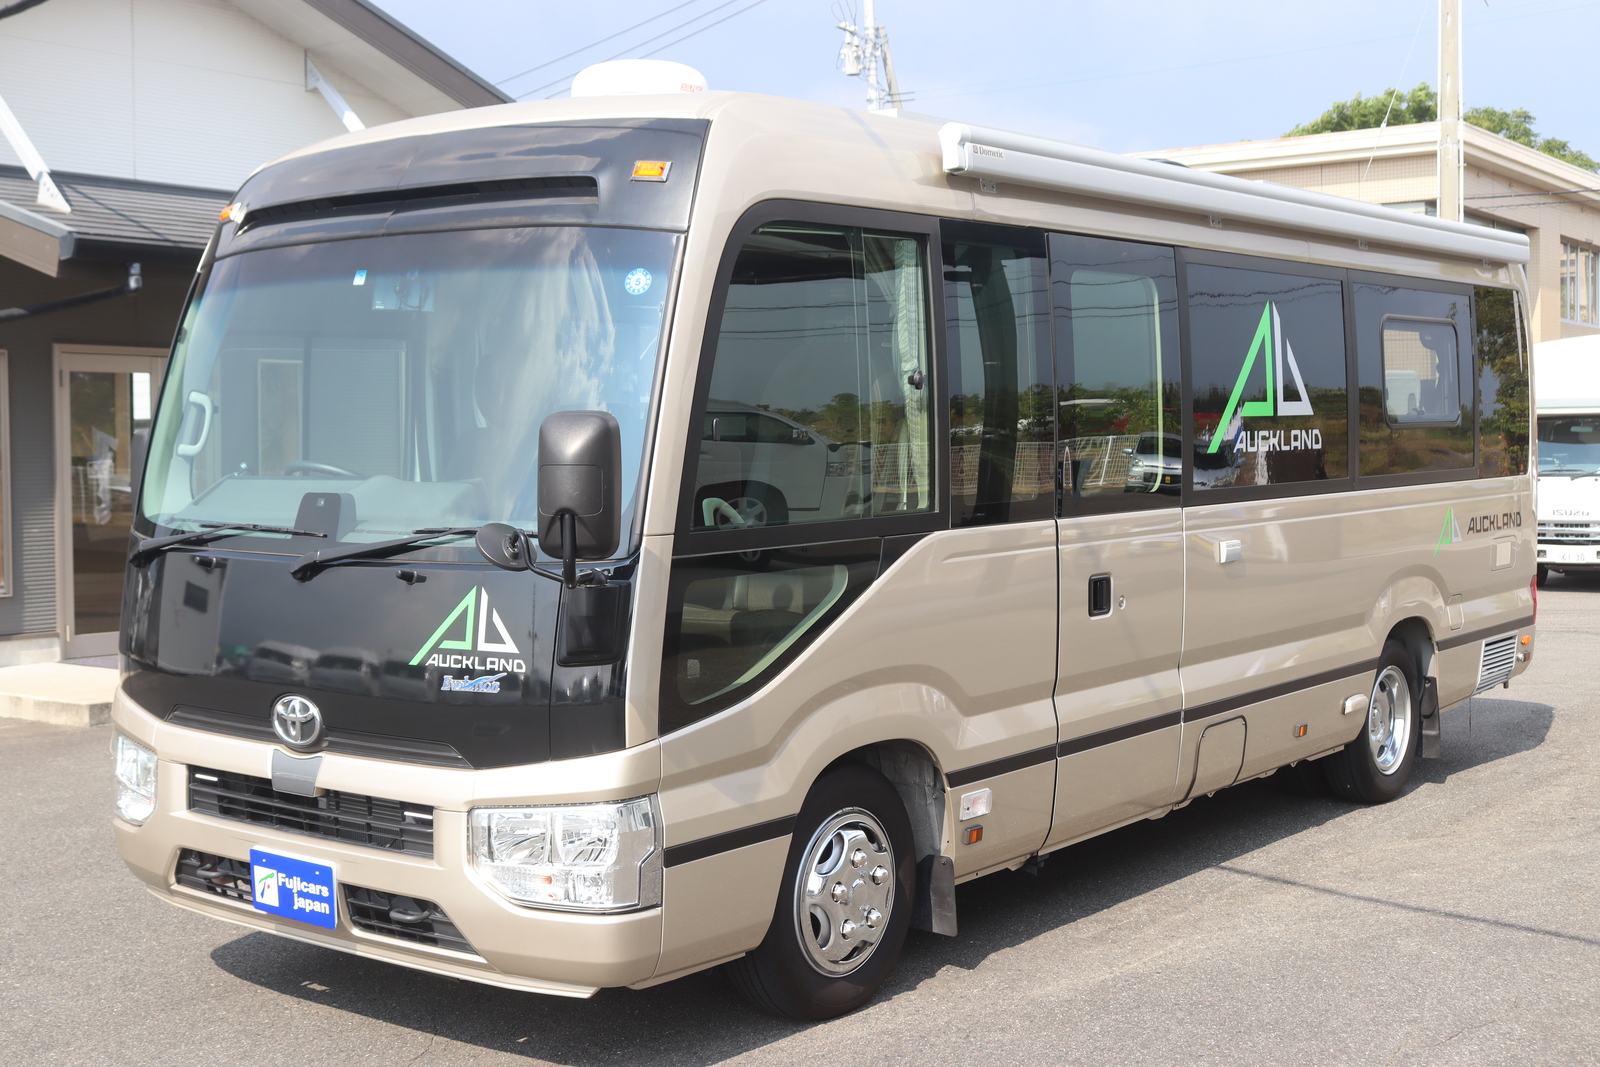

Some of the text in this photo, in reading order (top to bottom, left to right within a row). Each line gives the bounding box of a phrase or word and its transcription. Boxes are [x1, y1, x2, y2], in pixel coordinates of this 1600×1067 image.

[979, 146, 1004, 158] Dometic
[1233, 428, 1322, 453] AUCKLAND
[1466, 511, 1522, 535] AUCKLAND
[425, 654, 526, 672] AUCKLAND
[277, 872, 329, 897] Fujicars
[293, 893, 330, 914] japan
